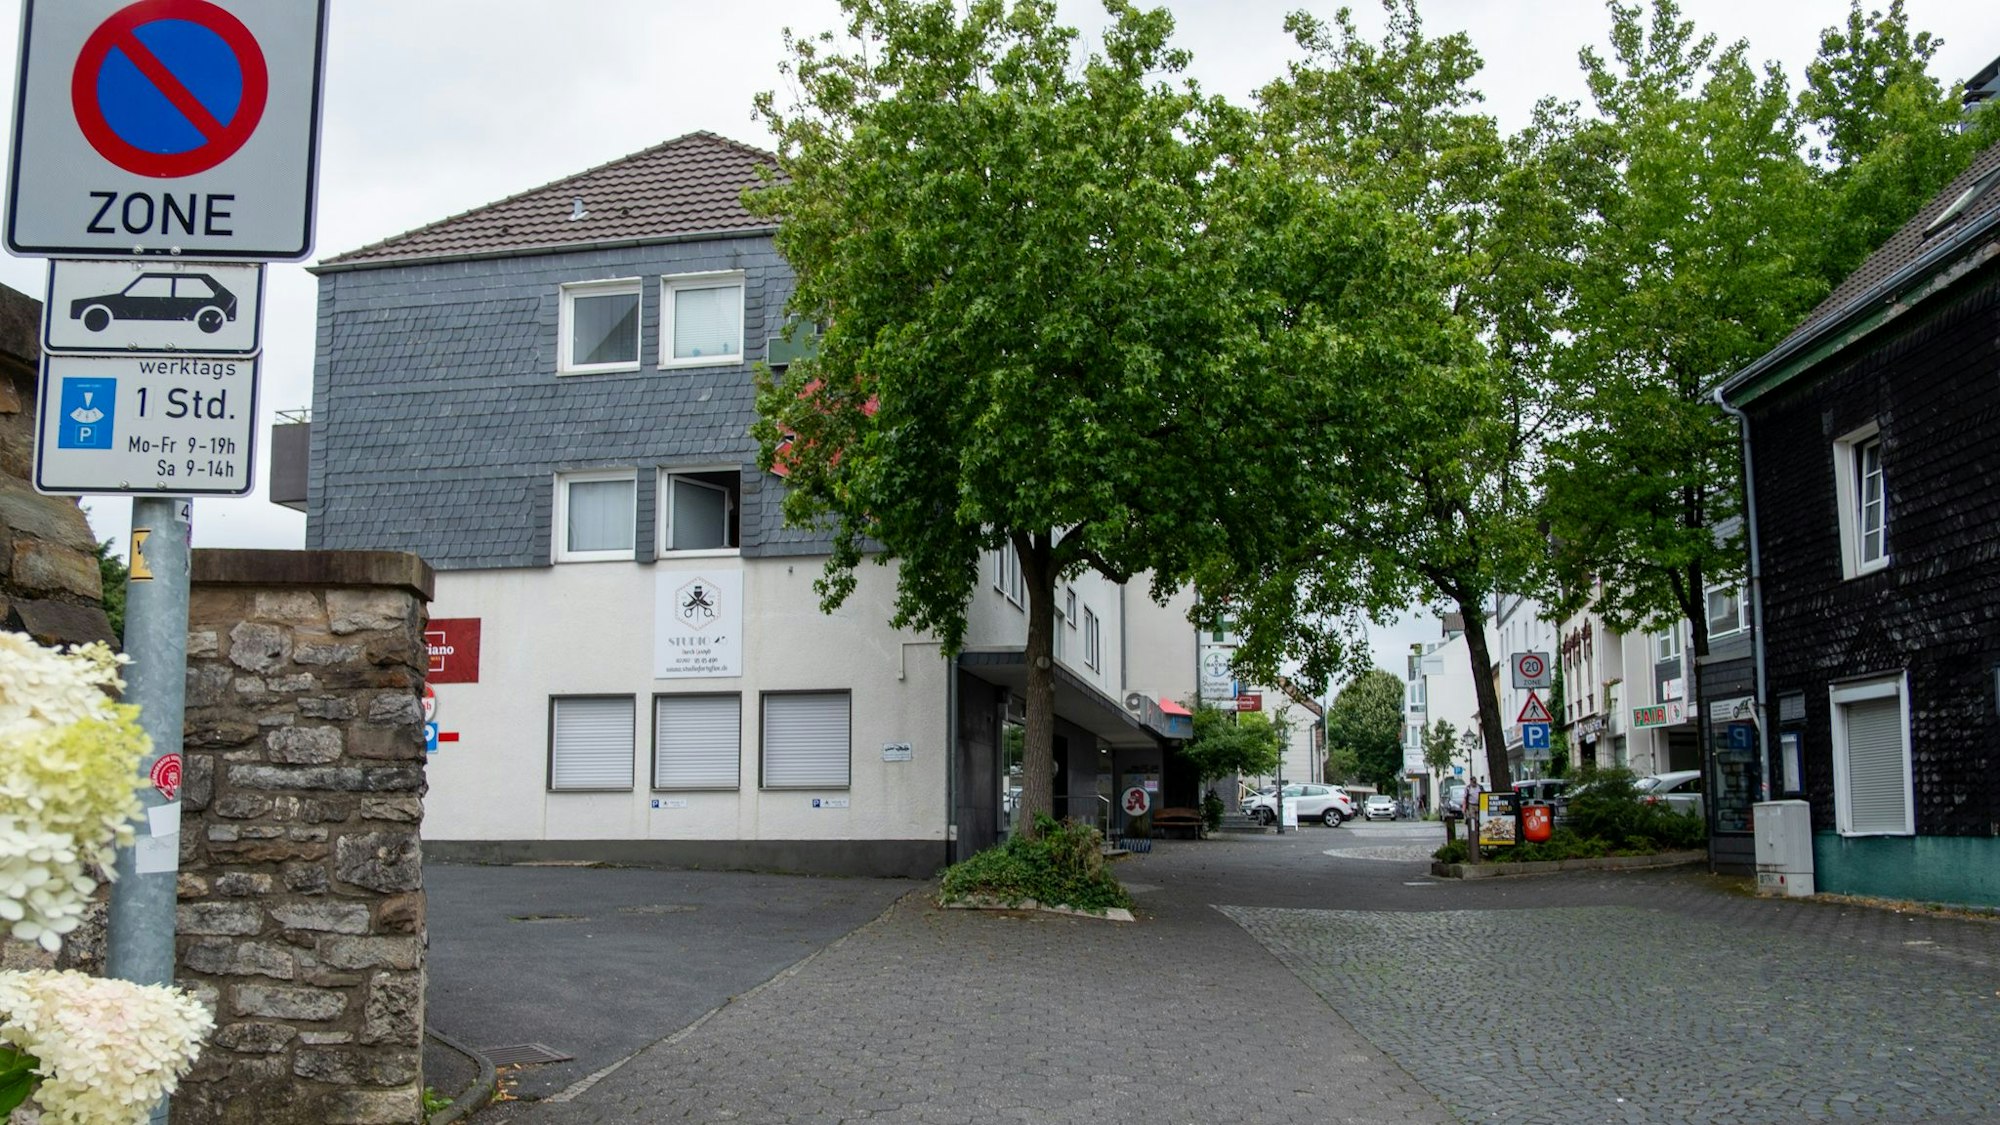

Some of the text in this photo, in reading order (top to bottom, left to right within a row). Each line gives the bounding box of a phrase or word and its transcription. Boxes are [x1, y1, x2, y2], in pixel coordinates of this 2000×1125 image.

[86, 191, 235, 236] ZONE
[140, 358, 236, 380] werktags
[137, 387, 235, 419] 1 Std.
[80, 427, 92, 442] P
[128, 436, 235, 455] Mo-Fr 9-19h
[157, 459, 234, 477] Sa 9-14h
[181, 503, 190, 521] 4
[1524, 662, 1539, 672] 20
[1635, 708, 1665, 725] FAIR
[1528, 726, 1543, 746] P
